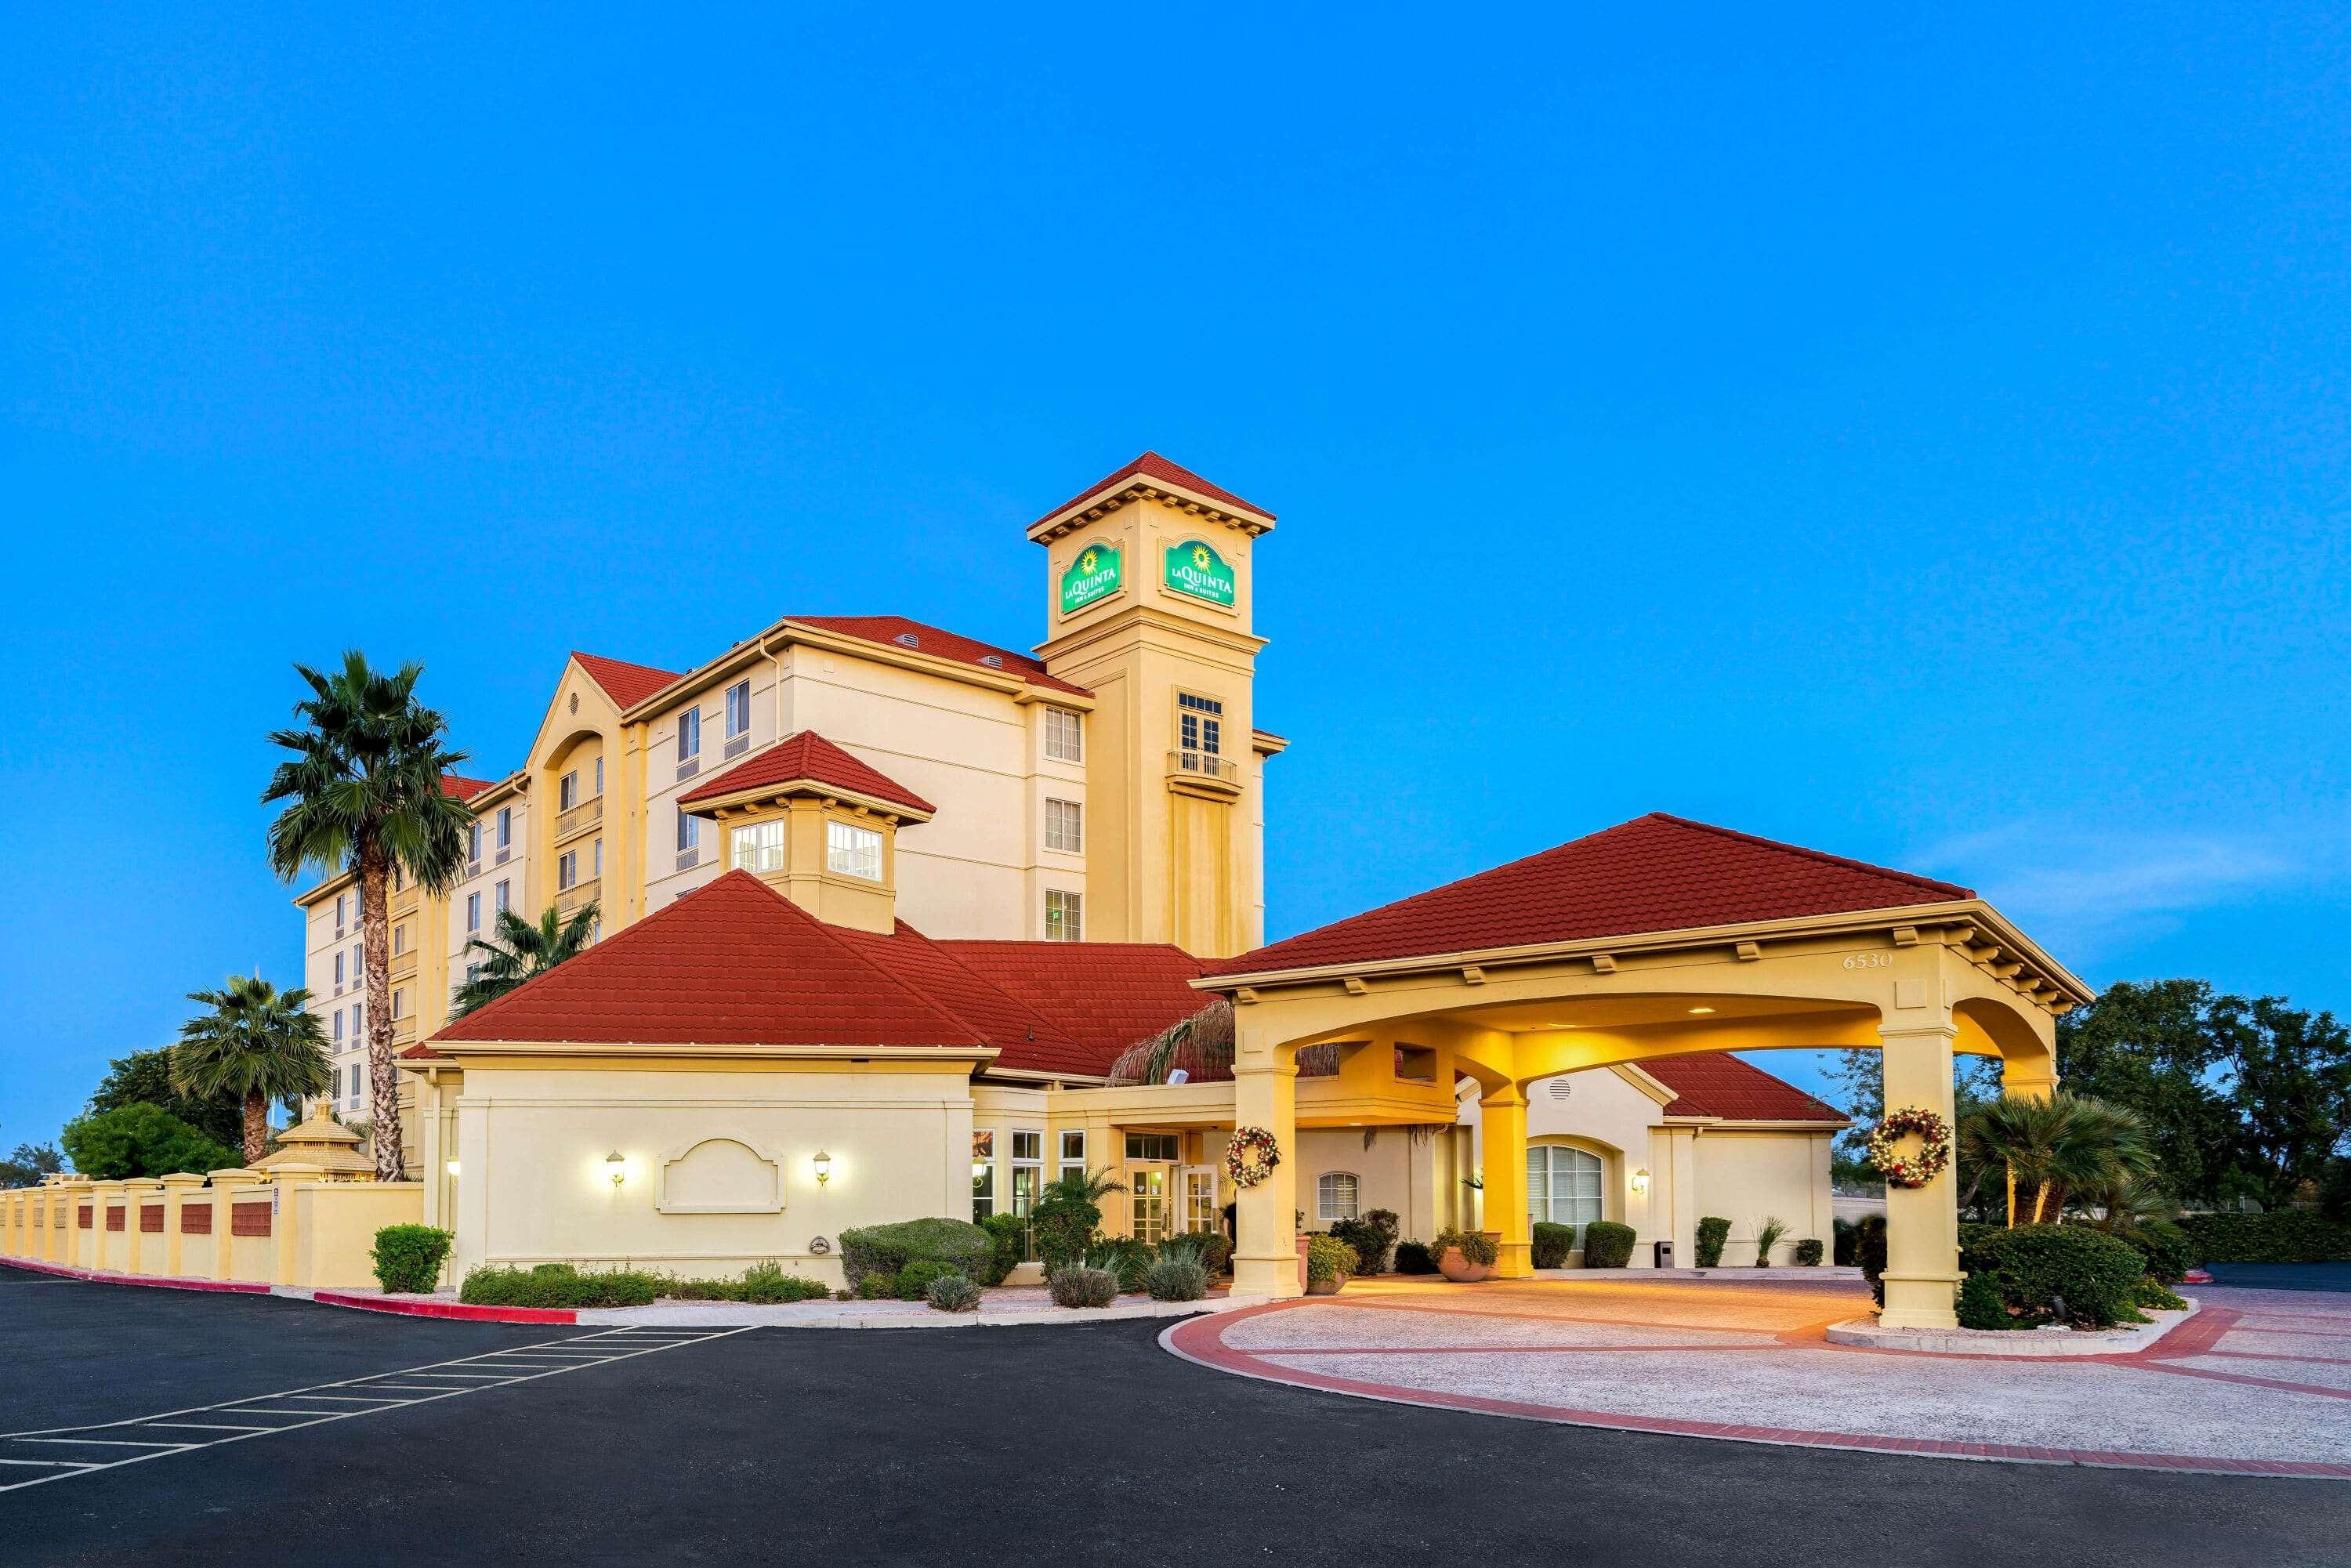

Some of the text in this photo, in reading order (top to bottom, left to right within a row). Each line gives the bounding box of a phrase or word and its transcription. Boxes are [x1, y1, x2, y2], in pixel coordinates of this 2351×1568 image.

[1065, 567, 1116, 599] LA QUINTA
[1172, 565, 1233, 594] LA QUINTA
[1183, 582, 1194, 591] INN
[1199, 587, 1219, 599] SUITES
[1842, 953, 1893, 970] 6530
